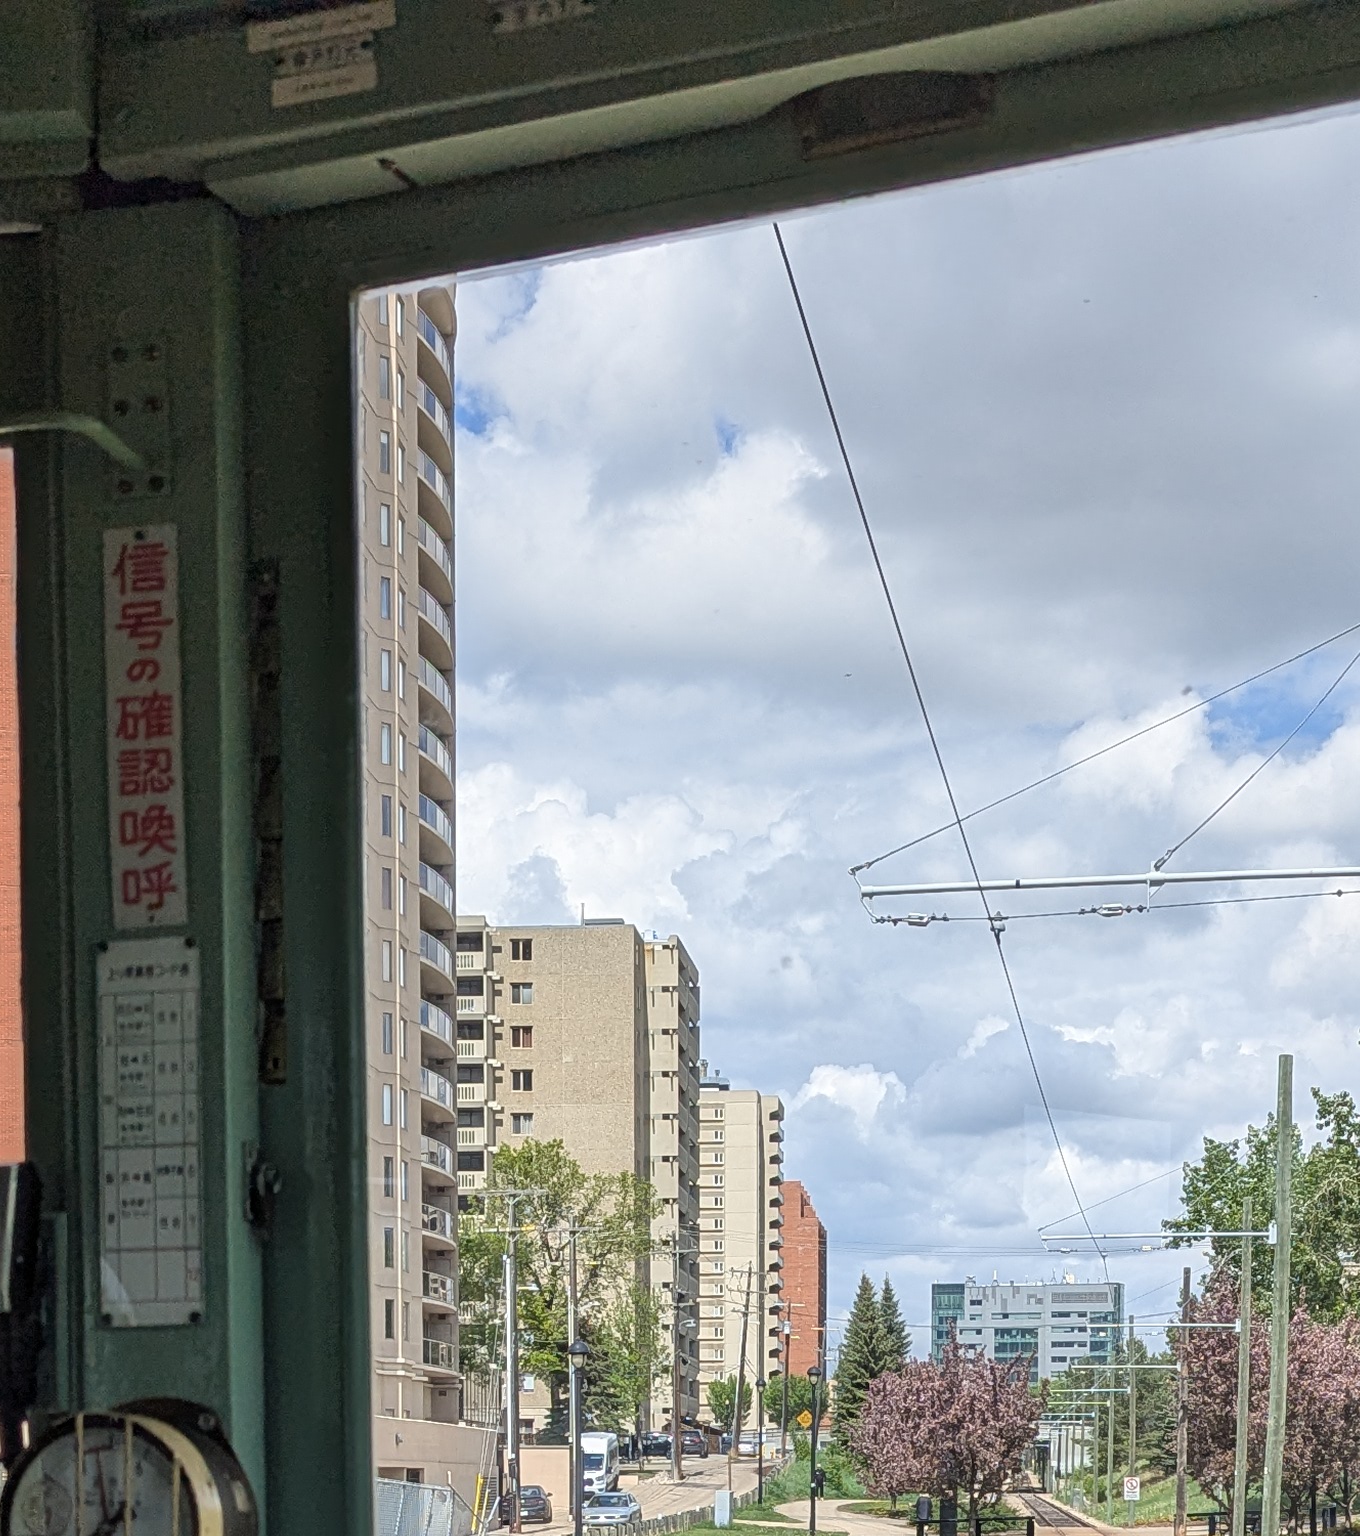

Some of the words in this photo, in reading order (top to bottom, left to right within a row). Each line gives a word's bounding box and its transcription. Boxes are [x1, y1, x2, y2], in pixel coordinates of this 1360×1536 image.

[112, 542, 177, 910] 信号の確認喚呼
